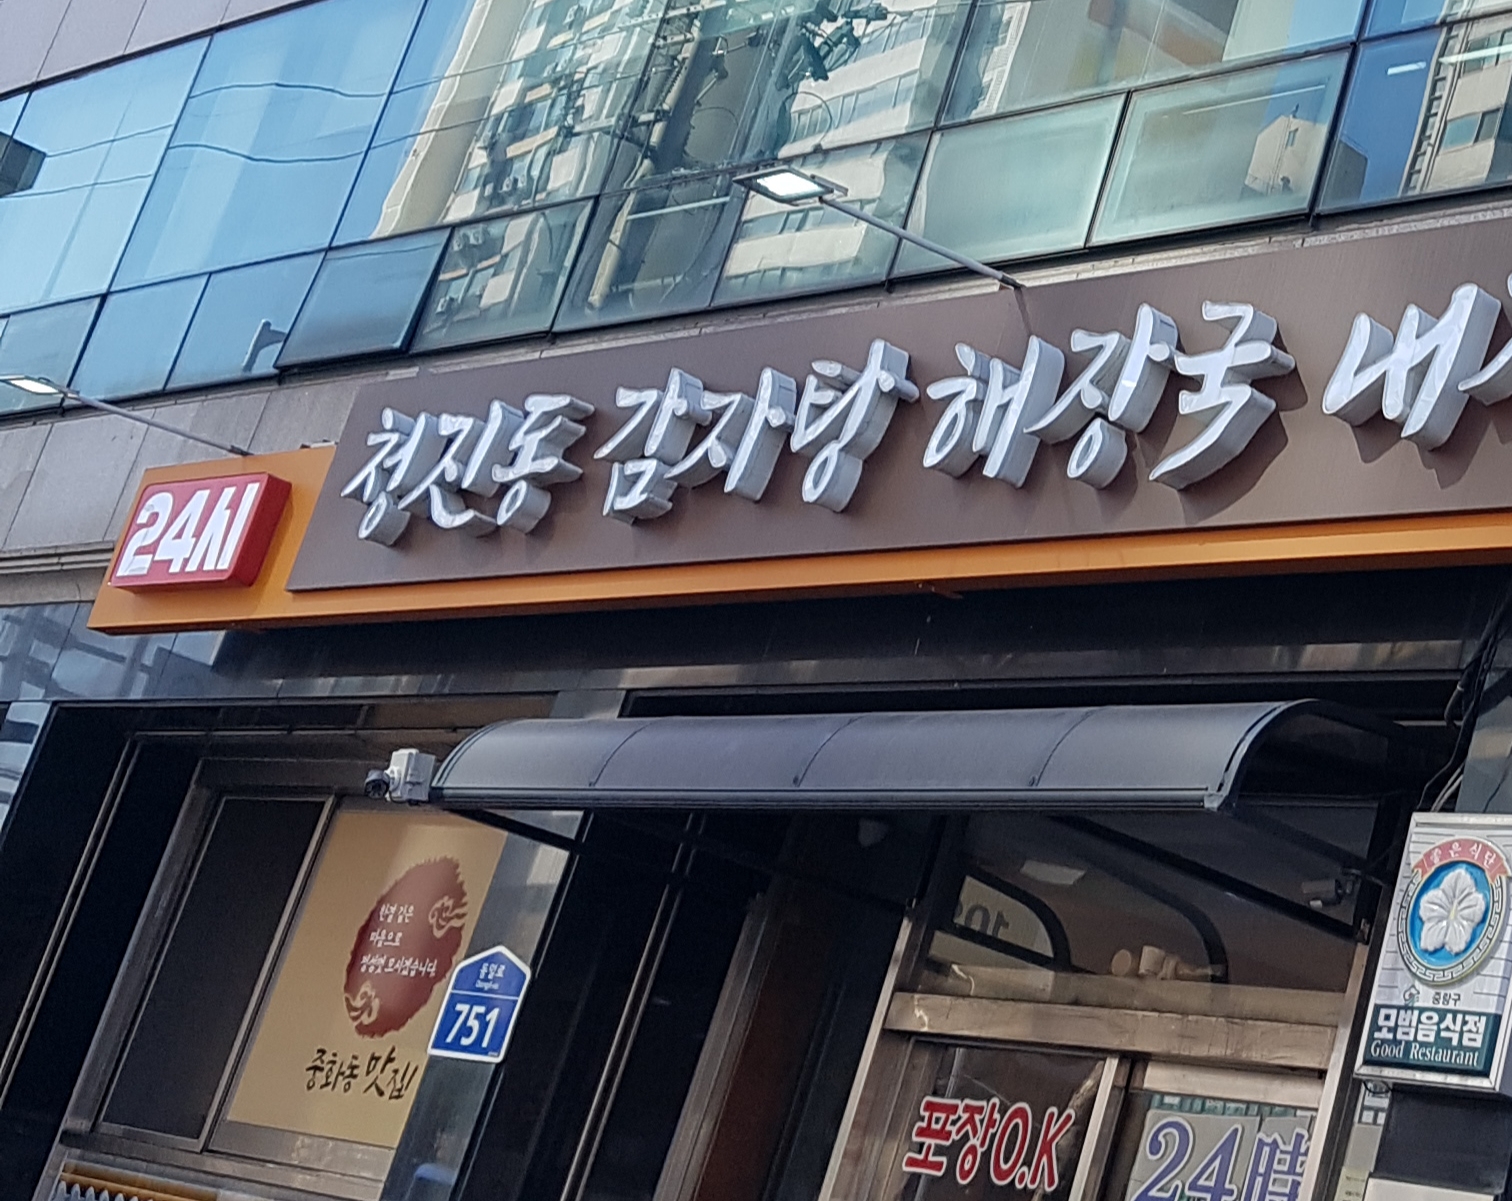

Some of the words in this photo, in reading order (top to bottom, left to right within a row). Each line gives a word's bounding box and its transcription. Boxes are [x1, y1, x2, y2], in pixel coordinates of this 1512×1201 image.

[341, 394, 596, 546] 청진동
[595, 338, 920, 525] 감자탕
[922, 300, 1297, 492] 해장국
[116, 481, 261, 578] 24시
[369, 928, 403, 949] 마음으로
[479, 962, 506, 979] 동일로
[445, 1003, 500, 1048] 751
[1373, 1007, 1487, 1048] 모범음식점
[305, 1047, 361, 1093] 중화동
[1370, 1040, 1405, 1059] Good
[1409, 1042, 1480, 1067] Restaurant
